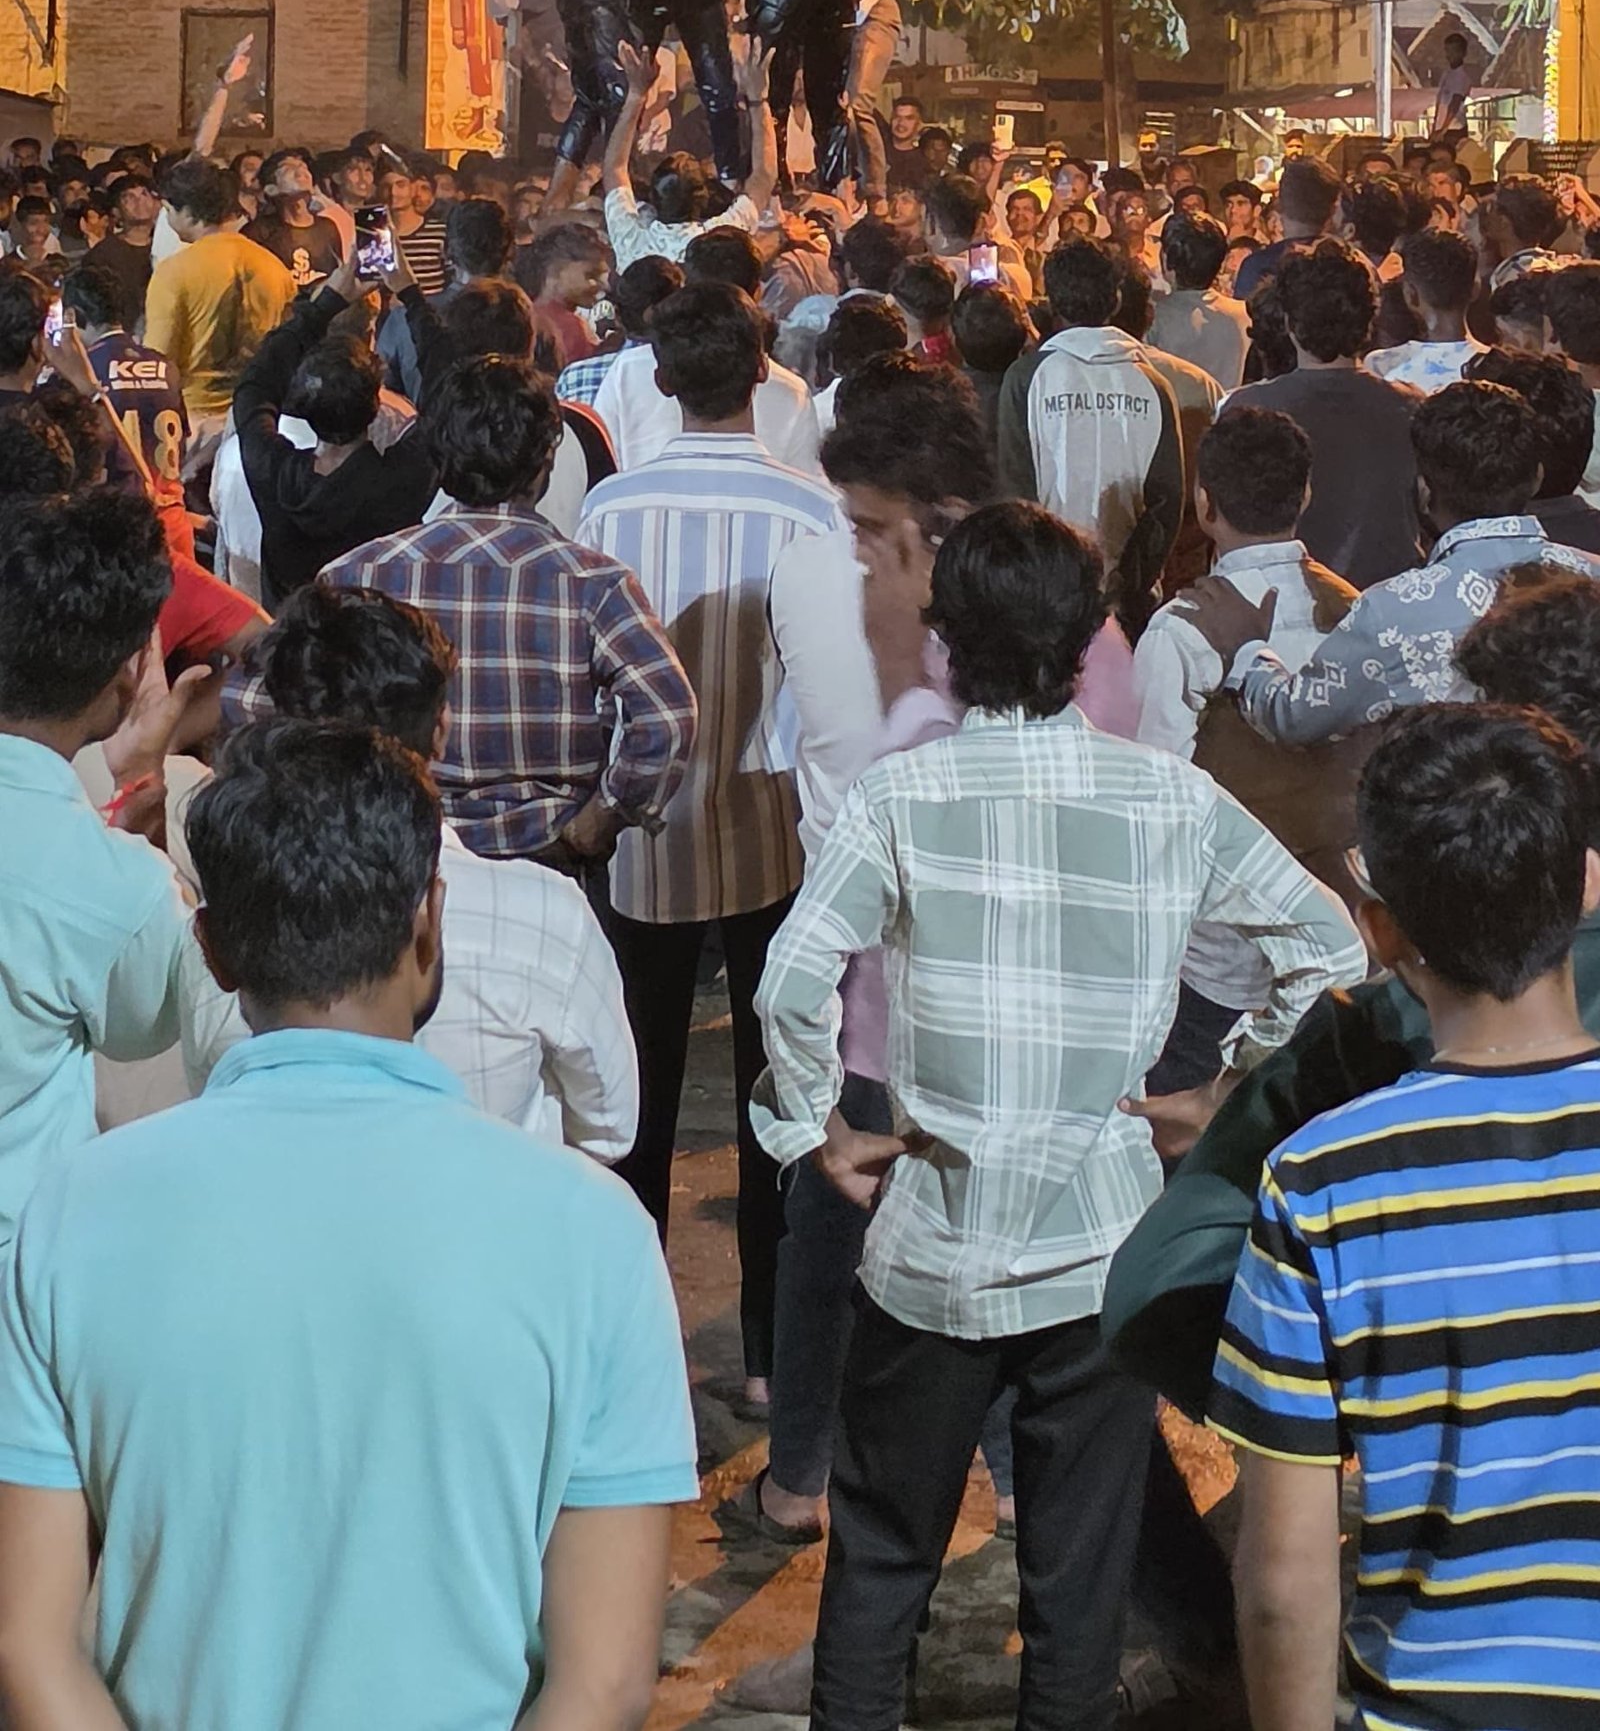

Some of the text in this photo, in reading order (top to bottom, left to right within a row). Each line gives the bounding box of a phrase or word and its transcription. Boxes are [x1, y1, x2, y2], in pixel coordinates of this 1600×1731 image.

[109, 360, 167, 379] KEI
[1044, 392, 1092, 414] METAL
[1096, 392, 1150, 415] DSTRCT
